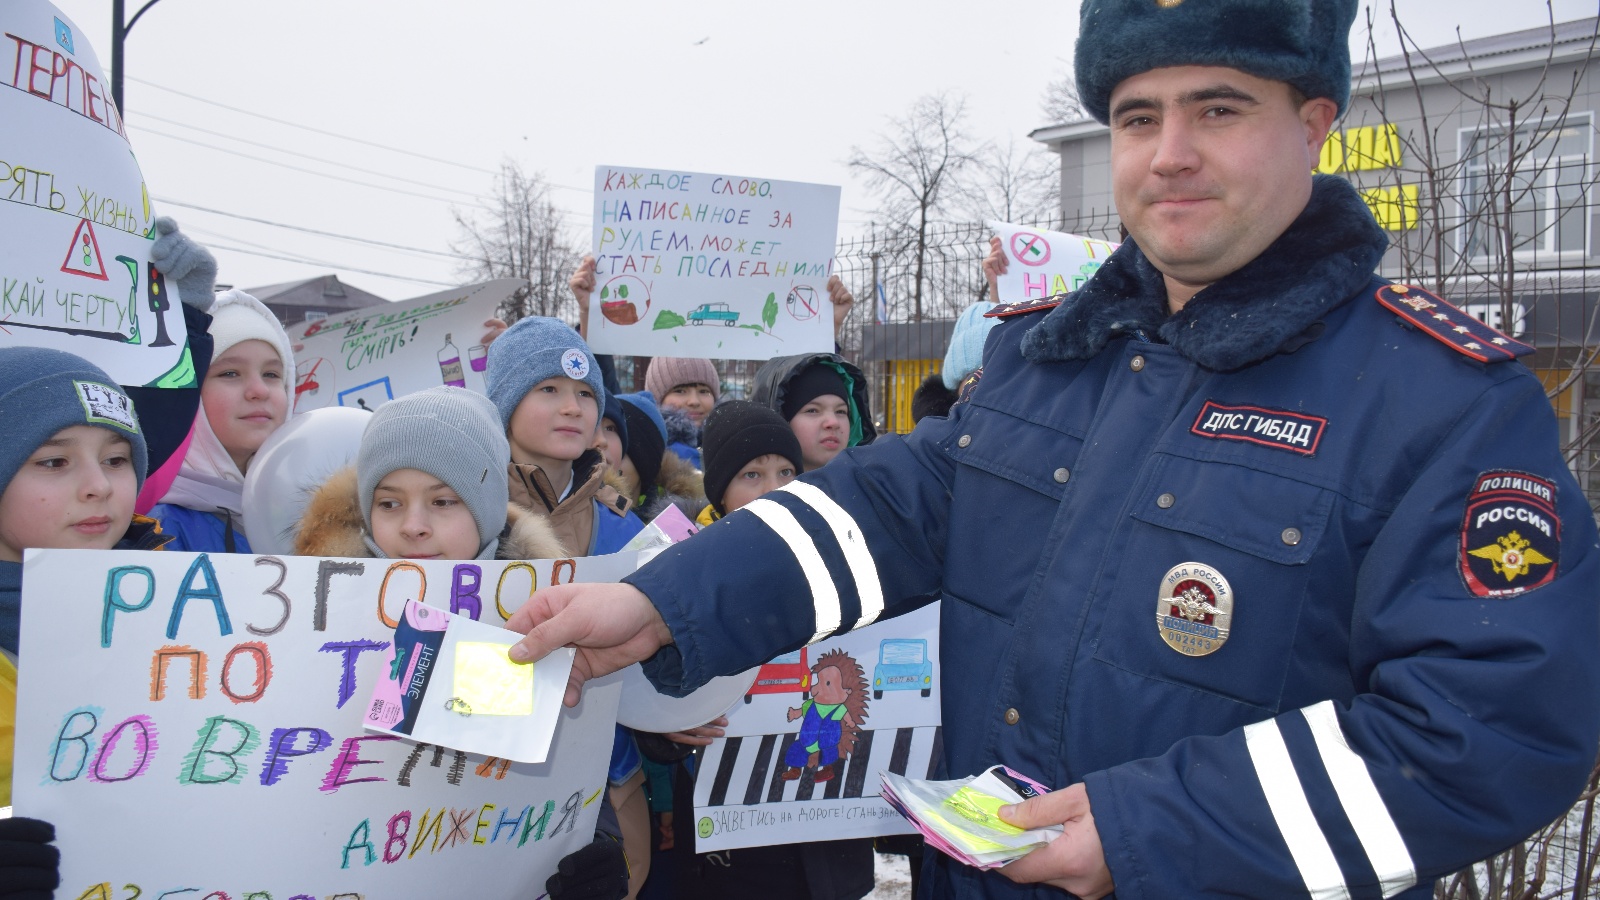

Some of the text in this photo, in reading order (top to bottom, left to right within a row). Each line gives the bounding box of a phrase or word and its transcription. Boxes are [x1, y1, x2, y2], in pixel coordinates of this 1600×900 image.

[1311, 122, 1402, 175] ОЛА
[603, 169, 773, 199] КАЖДОЕ СЛОВО,
[77, 181, 151, 236] ЖИЗНЬ!
[602, 199, 792, 228] НАПИСАННОЕ ЗА
[599, 227, 782, 256] РУЛЕМ, МОЖЕТ
[596, 254, 833, 279] СТАТЬ ПОСЛЕДНИМ!
[56, 285, 136, 335] ЧЕРТУ!
[1202, 411, 1313, 448] ДПС ГИБДД
[1478, 477, 1551, 502] ПОЛИЦИЯ
[1476, 506, 1552, 538] РОССИЯ
[1168, 568, 1227, 596] МВД РОССИИ
[1164, 617, 1217, 638] ПОЛИЦИЯ
[150, 641, 274, 705] ПО
[407, 644, 434, 700] ЭЛЕМЕНТ
[39, 704, 160, 787] ВО
[713, 805, 901, 836] ЗАСВЕТИСЬ НА ДОРОГЕ! СТАНЬ ЗАМЕ
